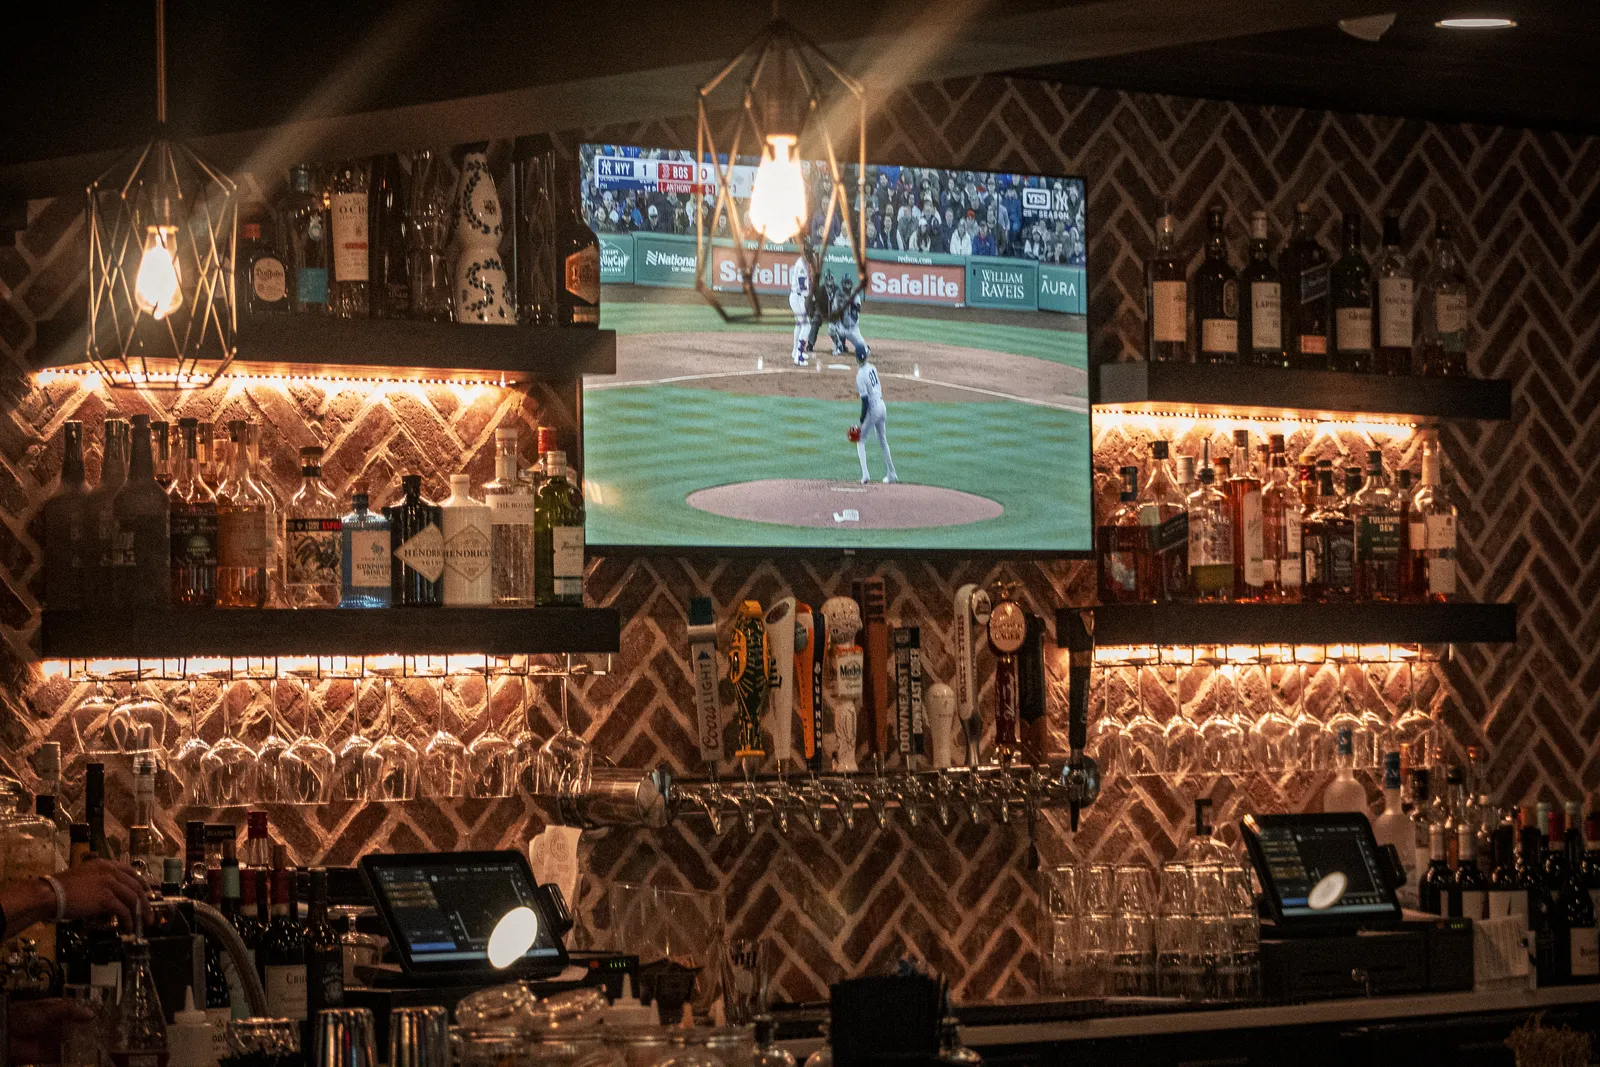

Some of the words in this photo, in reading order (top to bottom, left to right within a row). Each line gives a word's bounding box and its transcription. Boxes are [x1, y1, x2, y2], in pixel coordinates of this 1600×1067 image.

[614, 162, 631, 176] NYY
[642, 164, 647, 176] 1
[672, 167, 689, 179] BOS
[701, 168, 708, 180] 0
[667, 182, 692, 194] ANTHONY
[1026, 193, 1046, 205] YES
[1038, 210, 1069, 220] SEASON
[658, 252, 697, 267] National
[897, 255, 932, 265] redsox.com
[981, 268, 1023, 284] WILLIAM
[871, 271, 959, 298] Safelite
[981, 281, 1024, 299] RAVEIS
[700, 662, 714, 703] LIGHT
[898, 666, 911, 753] DOWNEAST
[702, 706, 719, 750] Coors
[815, 710, 823, 749] MOON
